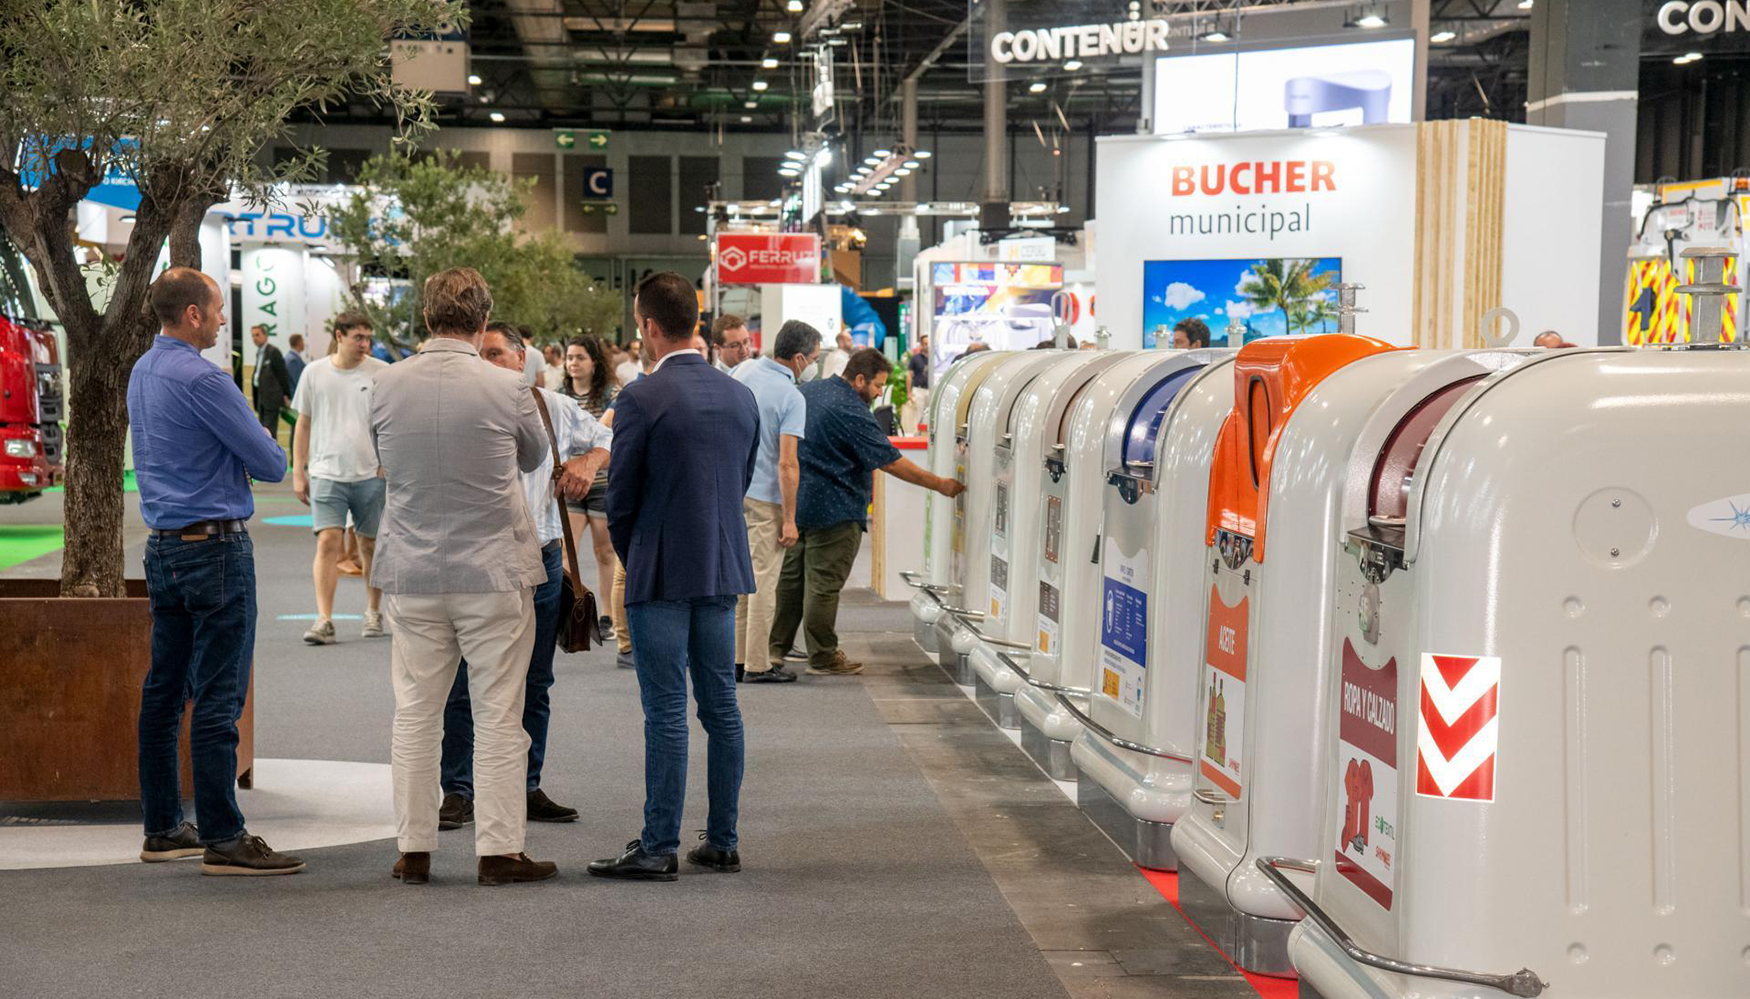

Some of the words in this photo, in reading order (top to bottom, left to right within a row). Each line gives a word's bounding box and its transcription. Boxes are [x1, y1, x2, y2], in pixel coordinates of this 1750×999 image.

[590, 171, 607, 194] C
[1171, 160, 1337, 197] BUCHER
[1170, 203, 1310, 241] municipal
[1218, 624, 1236, 656] ACEITE
[1344, 681, 1361, 718] ROPA
[1361, 688, 1367, 720] Y
[1367, 690, 1395, 735] CALZADO
